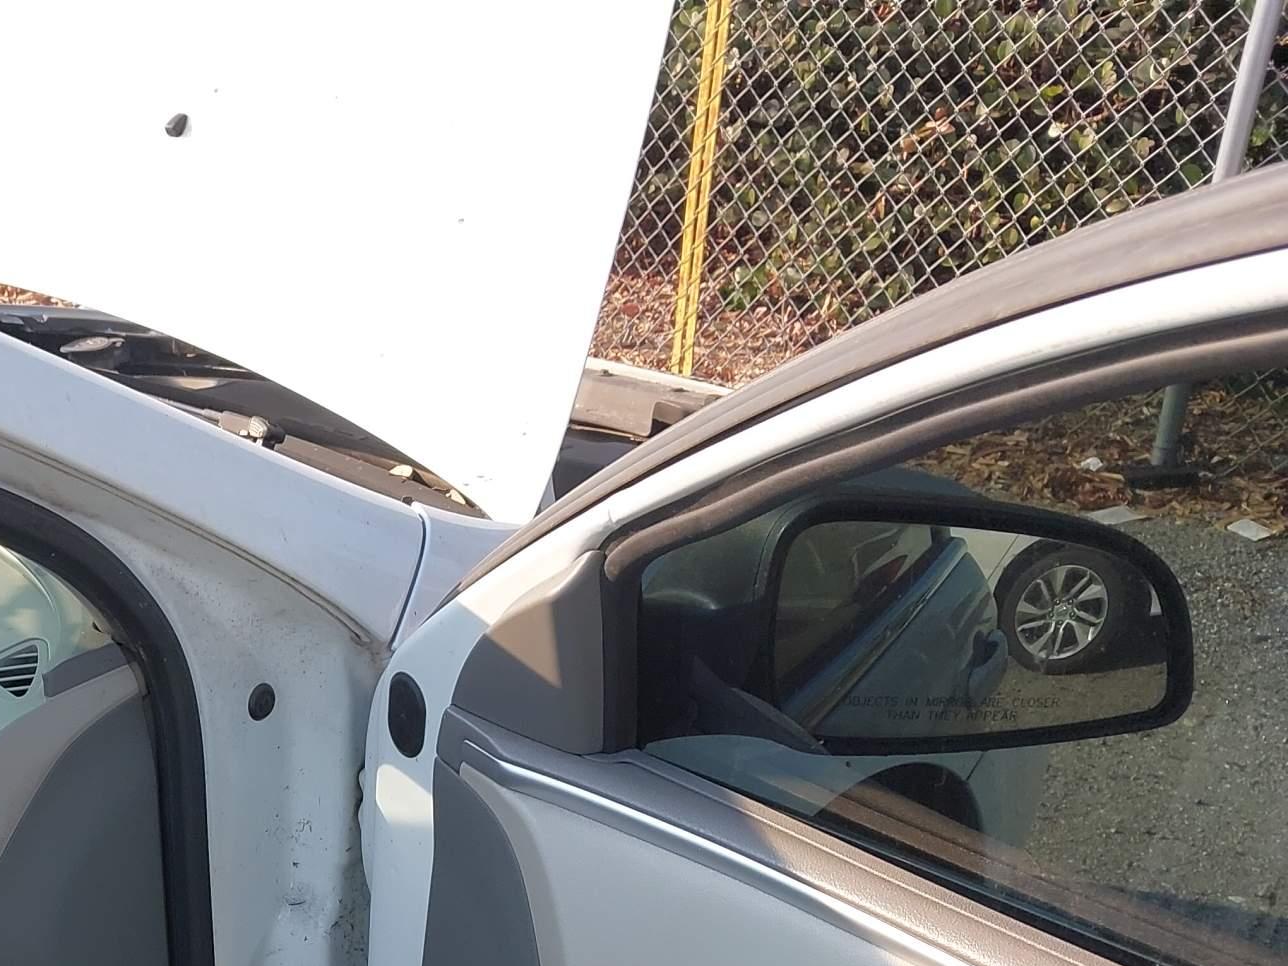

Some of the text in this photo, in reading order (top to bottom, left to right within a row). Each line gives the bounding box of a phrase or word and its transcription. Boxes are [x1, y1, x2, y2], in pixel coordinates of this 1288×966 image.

[905, 695, 919, 705] IN
[981, 696, 1004, 706] ARE
[1011, 697, 1061, 707] CLOSER
[887, 709, 1017, 721] THAN THEY APPEAR
